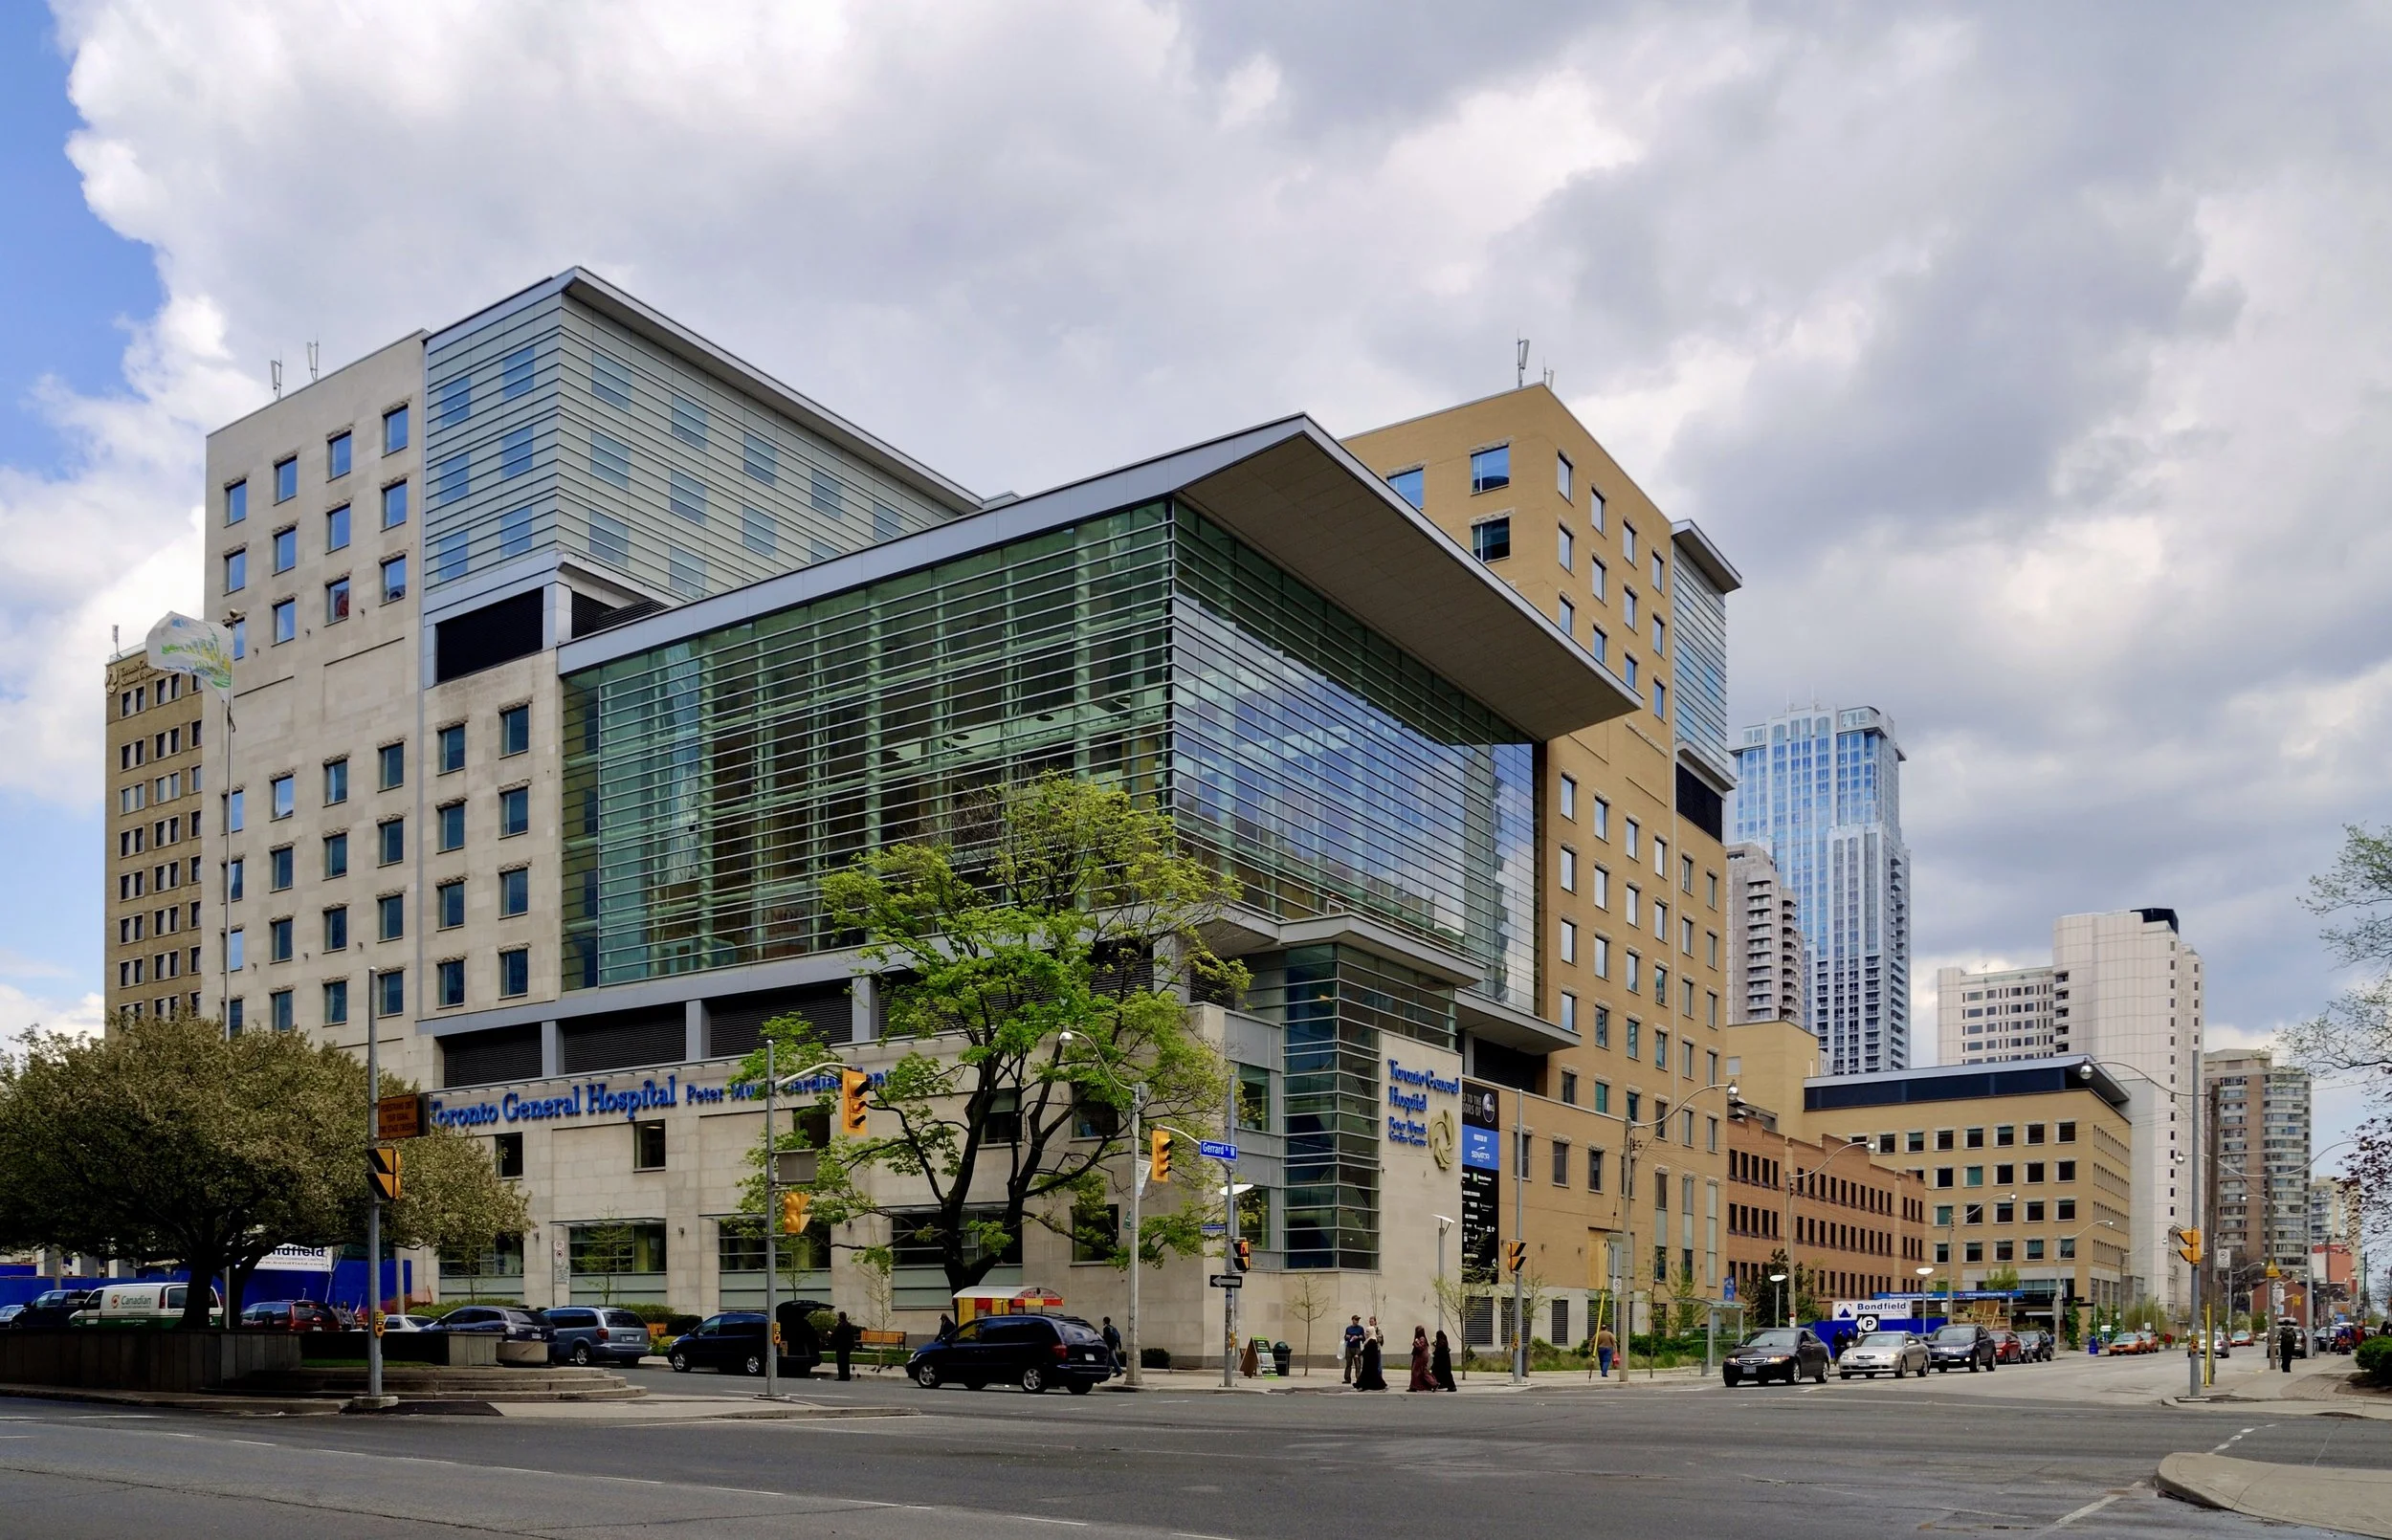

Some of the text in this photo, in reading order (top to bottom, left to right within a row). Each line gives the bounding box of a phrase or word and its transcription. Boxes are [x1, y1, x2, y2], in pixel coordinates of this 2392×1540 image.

[1387, 1059, 1459, 1094] Toronto General
[430, 1100, 498, 1126] Toronto
[502, 1085, 581, 1122] General
[586, 1074, 676, 1120] Hospital
[686, 1084, 724, 1103] Peter
[1389, 1086, 1427, 1113] Hospital
[1389, 1115, 1406, 1131] Peter
[1203, 1143, 1224, 1155] Gerrard
[1230, 1146, 1235, 1156] W
[122, 1295, 151, 1305] Canadian
[1857, 1302, 1906, 1310] Bondfield
[1866, 1319, 1873, 1328] P
